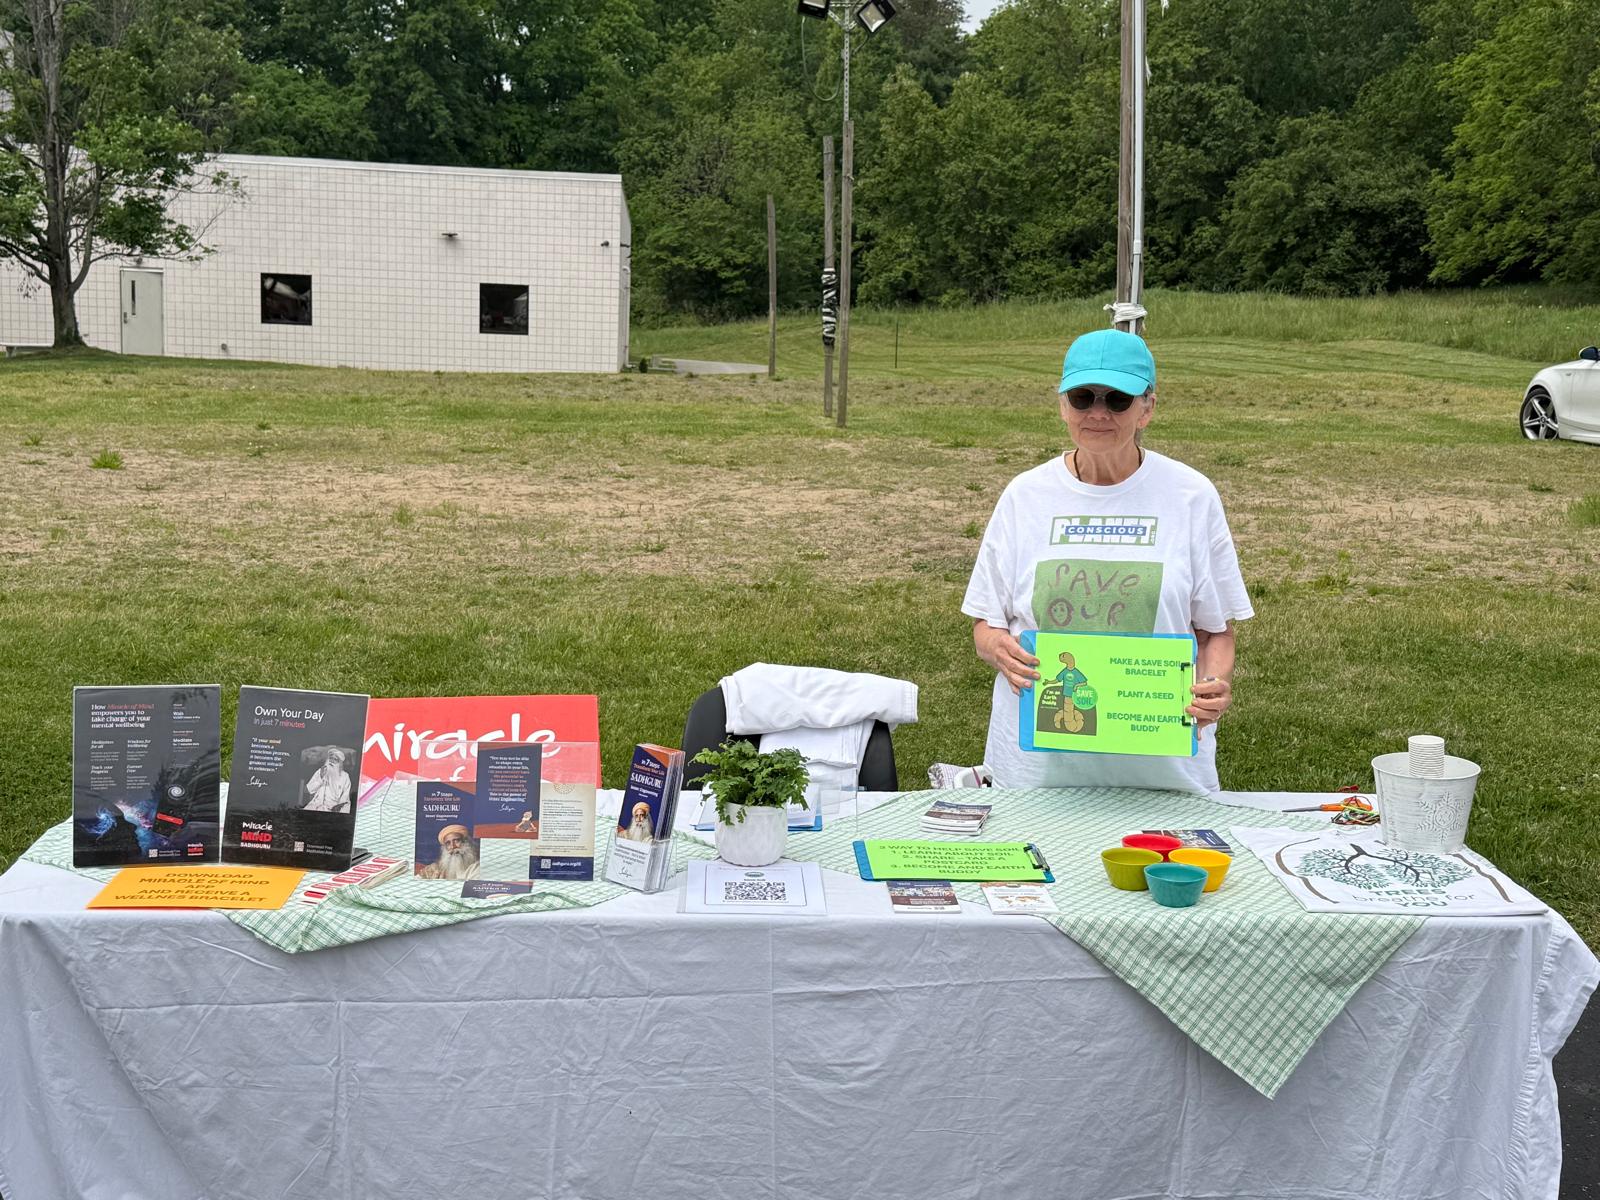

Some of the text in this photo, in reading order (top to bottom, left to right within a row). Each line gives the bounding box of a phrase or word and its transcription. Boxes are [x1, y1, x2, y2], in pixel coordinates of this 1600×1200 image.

[1068, 527, 1144, 535] CONSCIOUS
[1141, 659, 1163, 667] SAVE
[1163, 660, 1182, 668] SOIL
[1125, 668, 1167, 677] BRACELET
[1117, 690, 1144, 698] PLANT
[1152, 692, 1174, 700] SEED
[1076, 697, 1093, 706] SOIL
[255, 705, 325, 723] Own Your Day
[1107, 713, 1143, 722] BECOME
[1156, 715, 1183, 724] EARTH
[106, 716, 127, 724] charge
[260, 718, 273, 728] just
[280, 720, 305, 729] minutes
[1131, 724, 1160, 733] BUDDY
[630, 772, 663, 789] SADHGURU
[423, 804, 461, 812] SADHGURU
[241, 831, 272, 842] MIND
[240, 842, 271, 850] SADHGURU
[1369, 888, 1447, 896] TREES
